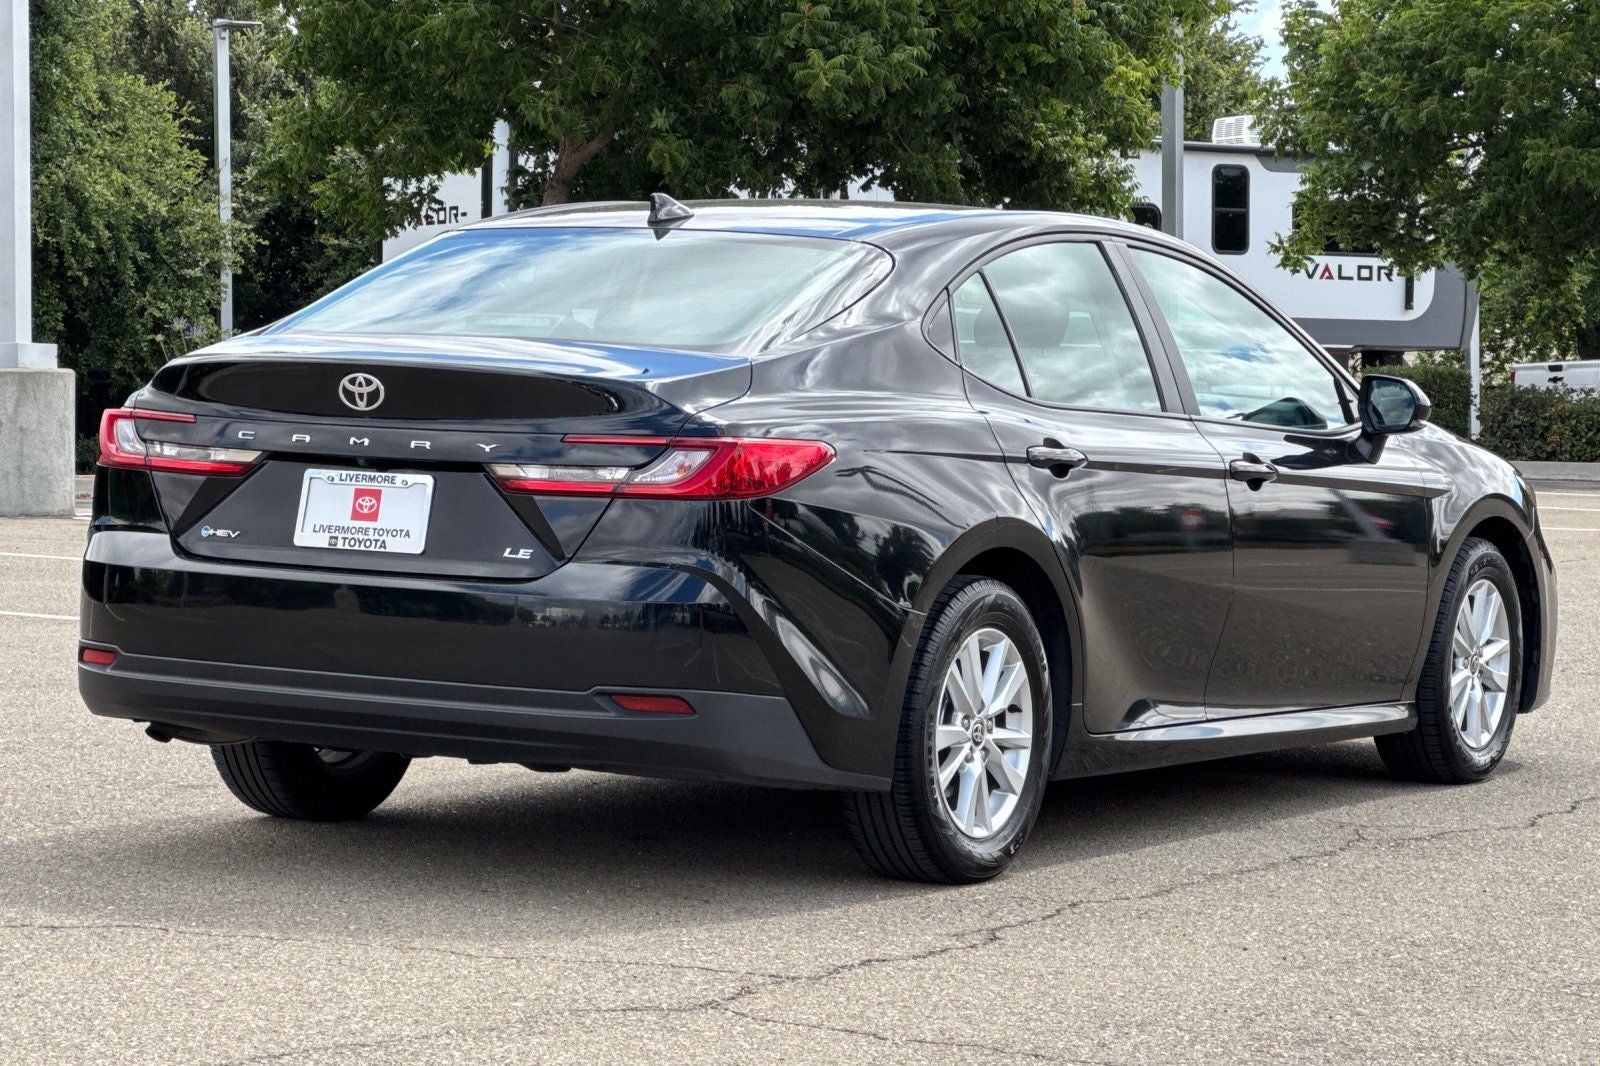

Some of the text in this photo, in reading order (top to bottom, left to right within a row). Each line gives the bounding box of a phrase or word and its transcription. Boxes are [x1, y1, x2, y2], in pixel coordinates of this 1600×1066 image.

[238, 430, 500, 452] CAMRY
[339, 473, 397, 485] LIVERMORE
[312, 523, 411, 539] LIVERMORE TOYOTA
[341, 537, 387, 550] TOYOTA
[502, 547, 534, 559] LE
